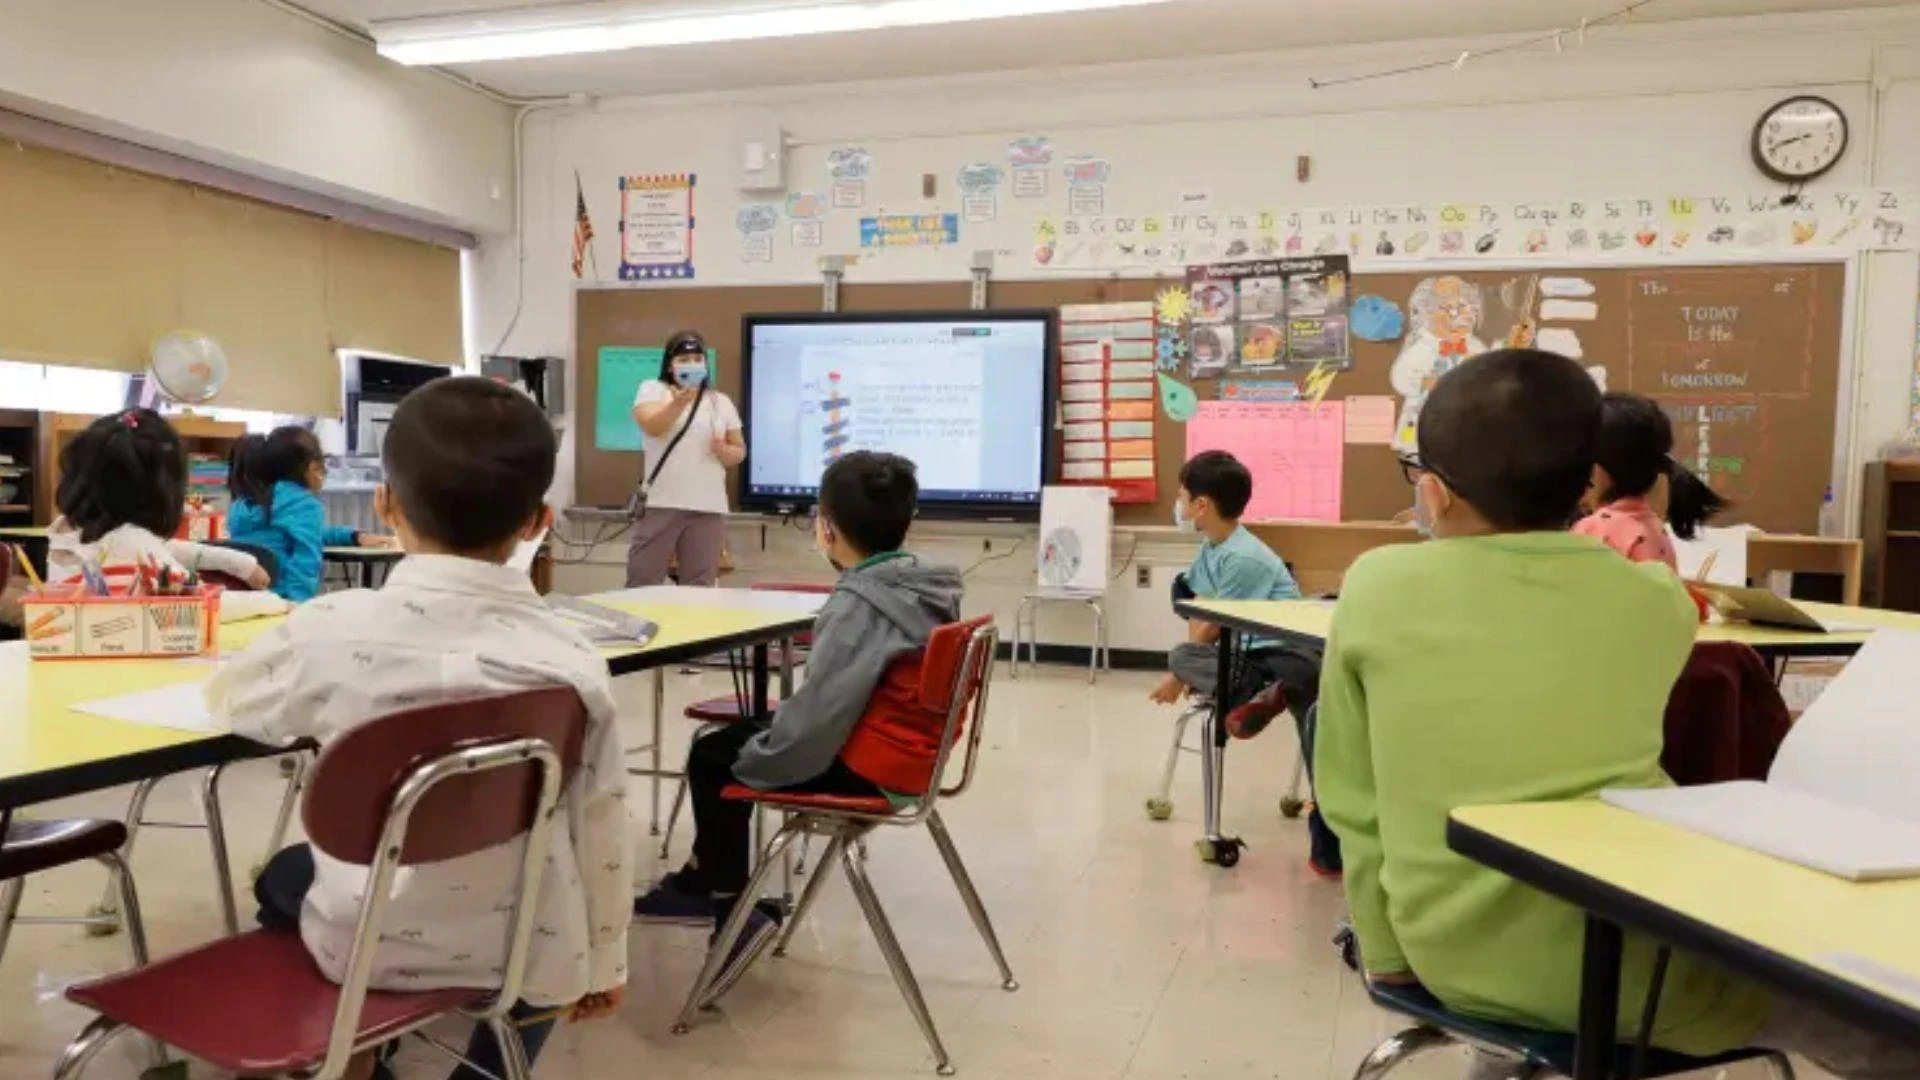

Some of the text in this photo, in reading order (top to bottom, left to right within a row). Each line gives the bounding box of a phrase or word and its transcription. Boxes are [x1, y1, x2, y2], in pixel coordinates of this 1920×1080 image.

[1115, 217, 1136, 232] Dd
[1196, 215, 1218, 235] Gg
[1440, 205, 1466, 222] Oo
[1479, 204, 1499, 225] Pp
[1834, 192, 1859, 215] Yy
[1878, 191, 1899, 209] Zz
[1680, 306, 1741, 322] TODAY
[1709, 323, 1735, 343] the
[1661, 371, 1750, 388] TOMORROW
